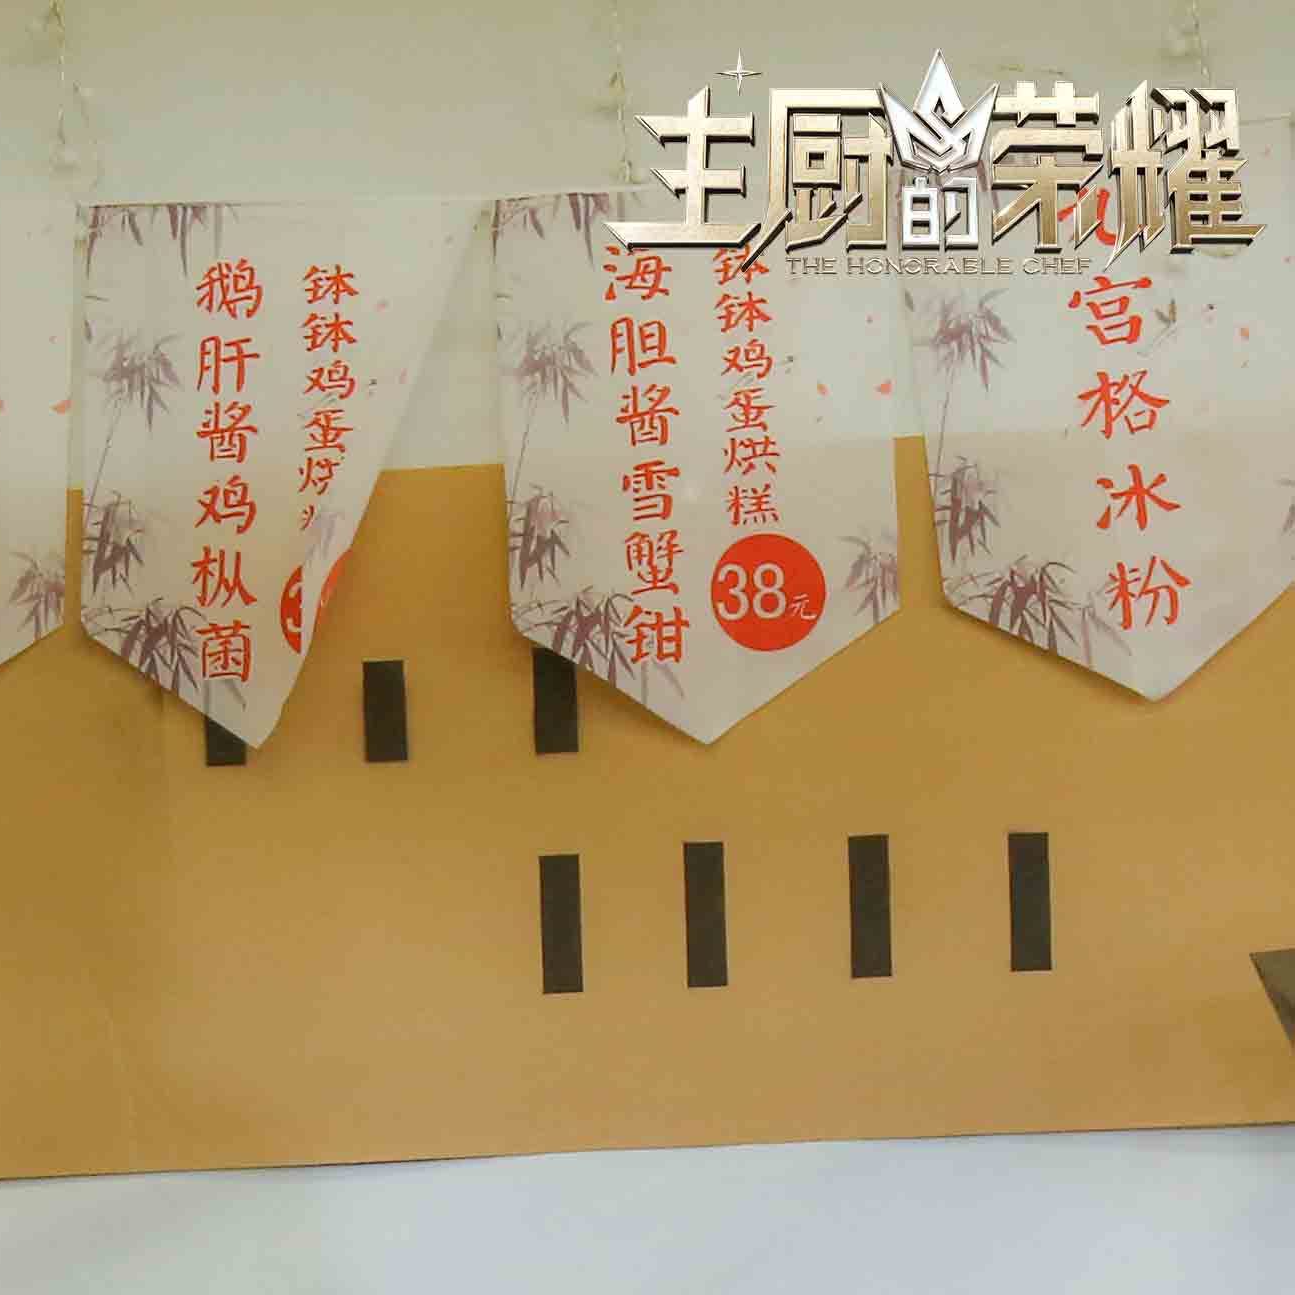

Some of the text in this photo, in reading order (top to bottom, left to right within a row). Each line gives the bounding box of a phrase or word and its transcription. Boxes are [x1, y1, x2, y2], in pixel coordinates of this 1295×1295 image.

[191, 257, 264, 683] 鹅肝酱鸡枞菌
[297, 264, 359, 531] 钵钵鸡蛋烘
[602, 243, 690, 665] 海胆酱雪蟹钳
[713, 244, 781, 528] 钵钵鸡蛋烘糕
